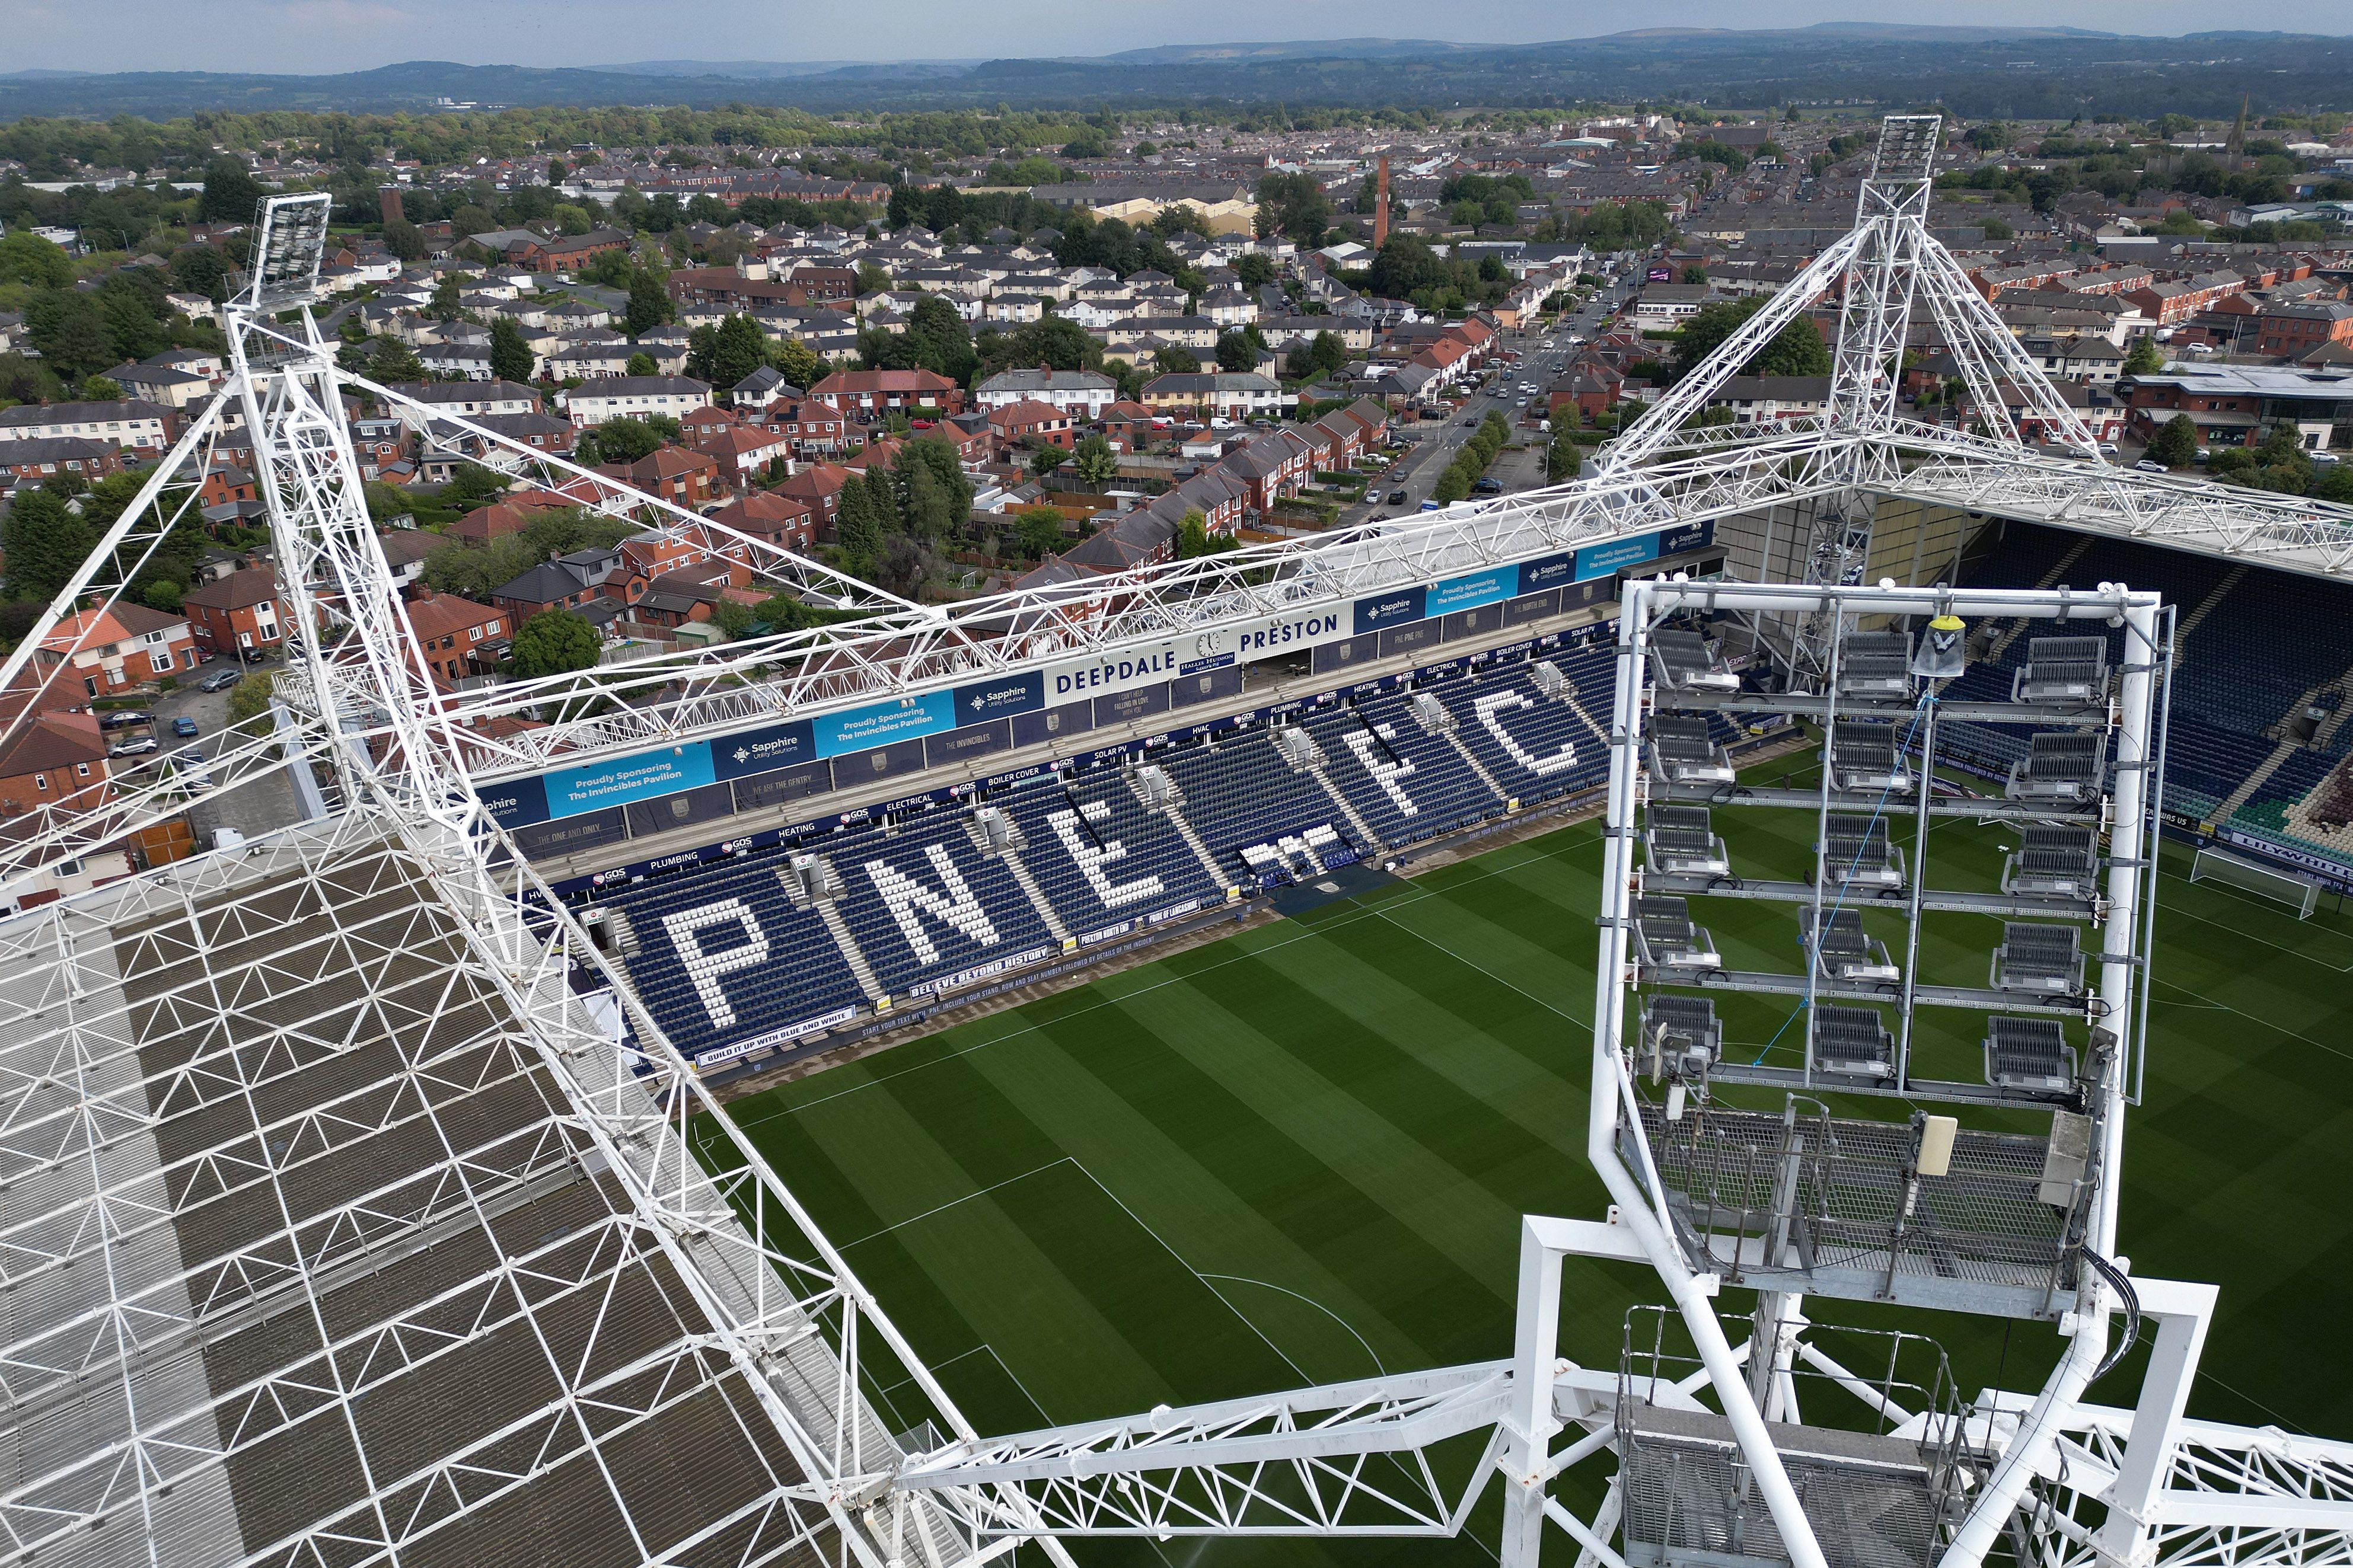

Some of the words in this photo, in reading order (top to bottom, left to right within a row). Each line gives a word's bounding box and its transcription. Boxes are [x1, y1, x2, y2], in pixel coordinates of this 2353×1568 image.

[1541, 562, 1567, 574] Sapphire
[1443, 586, 1464, 595] Proudly
[1465, 579, 1496, 590] Sponsoring
[1448, 591, 1477, 602] Invincibles
[1478, 586, 1500, 595] Pavilion
[1380, 599, 1410, 612] Sapphire
[1241, 614, 1337, 652] PRESTON
[1497, 647, 1515, 656] BOILER
[1516, 641, 1532, 651] COVER
[1181, 660, 1204, 670] HALLIS
[1206, 654, 1233, 664] HUDSON
[1427, 661, 1458, 674] ELECTRICAL
[1057, 652, 1175, 694] DEEPDALE
[1402, 671, 1414, 679] GOS
[987, 686, 1026, 701] Sapphire
[1354, 681, 1378, 693] HEATING
[1324, 691, 1337, 699] GOS
[1271, 701, 1301, 714] PLUMBING
[844, 718, 876, 730] Proudly
[878, 708, 924, 723] Sponsoring
[1242, 712, 1255, 720] GOS
[855, 724, 898, 738] Invincibles
[901, 716, 932, 727] Pavilion
[1193, 724, 1209, 734] HVAC
[752, 737, 797, 752] Sapphire
[946, 741, 956, 750] THE
[956, 733, 990, 748] INVINCIBLES
[1153, 734, 1168, 743] GOS
[1095, 748, 1116, 759] SOLAR
[1118, 745, 1127, 753] PV
[1059, 758, 1075, 767] GOS
[576, 775, 614, 788] Proudly
[617, 763, 671, 780] Sponsoring
[988, 774, 1014, 786] BOILER
[1016, 767, 1039, 779] COVER
[568, 792, 587, 801] The
[589, 780, 642, 797] Invincibles
[643, 771, 681, 784] Pavilion
[764, 784, 773, 793] ARE
[775, 781, 786, 790] THE
[788, 775, 811, 787] GENTRY
[959, 781, 976, 791] GOS
[486, 798, 516, 811] phire
[887, 794, 932, 811] ELECTRICAL
[850, 809, 868, 819] GOS
[538, 836, 551, 845] THE
[552, 832, 566, 842] ONE
[568, 828, 581, 837] AND
[583, 823, 600, 834] ONLY
[779, 823, 815, 838] HEATING
[733, 837, 752, 848] GOS
[651, 851, 697, 869] PLUMBING
[604, 868, 626, 879] GOS
[2316, 876, 2332, 886] YOUR
[2333, 881, 2346, 889] TEX
[1082, 931, 1103, 945] PRESTON
[1103, 927, 1119, 939] NORTH
[1120, 923, 1129, 934] END
[911, 976, 956, 998] BELEVE
[958, 963, 1003, 982] BEYOND
[1005, 949, 1047, 967] HISTORY
[862, 1020, 879, 1036] START
[880, 1017, 896, 1032] YOUR
[897, 1014, 910, 1025] TEXT
[943, 998, 965, 1009] INCLUDE
[966, 993, 980, 1003] YOUR
[1015, 978, 1026, 987] AND
[1027, 973, 1039, 984] SEAT
[1040, 966, 1061, 979] NUMBER
[1063, 958, 1088, 973] FOLLOWED
[1096, 949, 1115, 961] DETAILS
[1133, 935, 1155, 949] INCIDENT
[707, 1048, 732, 1062] BUILD
[744, 1042, 755, 1050] UP
[757, 1034, 779, 1046] WITH
[781, 1028, 801, 1038] BLUE
[802, 1021, 819, 1032] AND
[821, 1013, 846, 1026] WHITE
